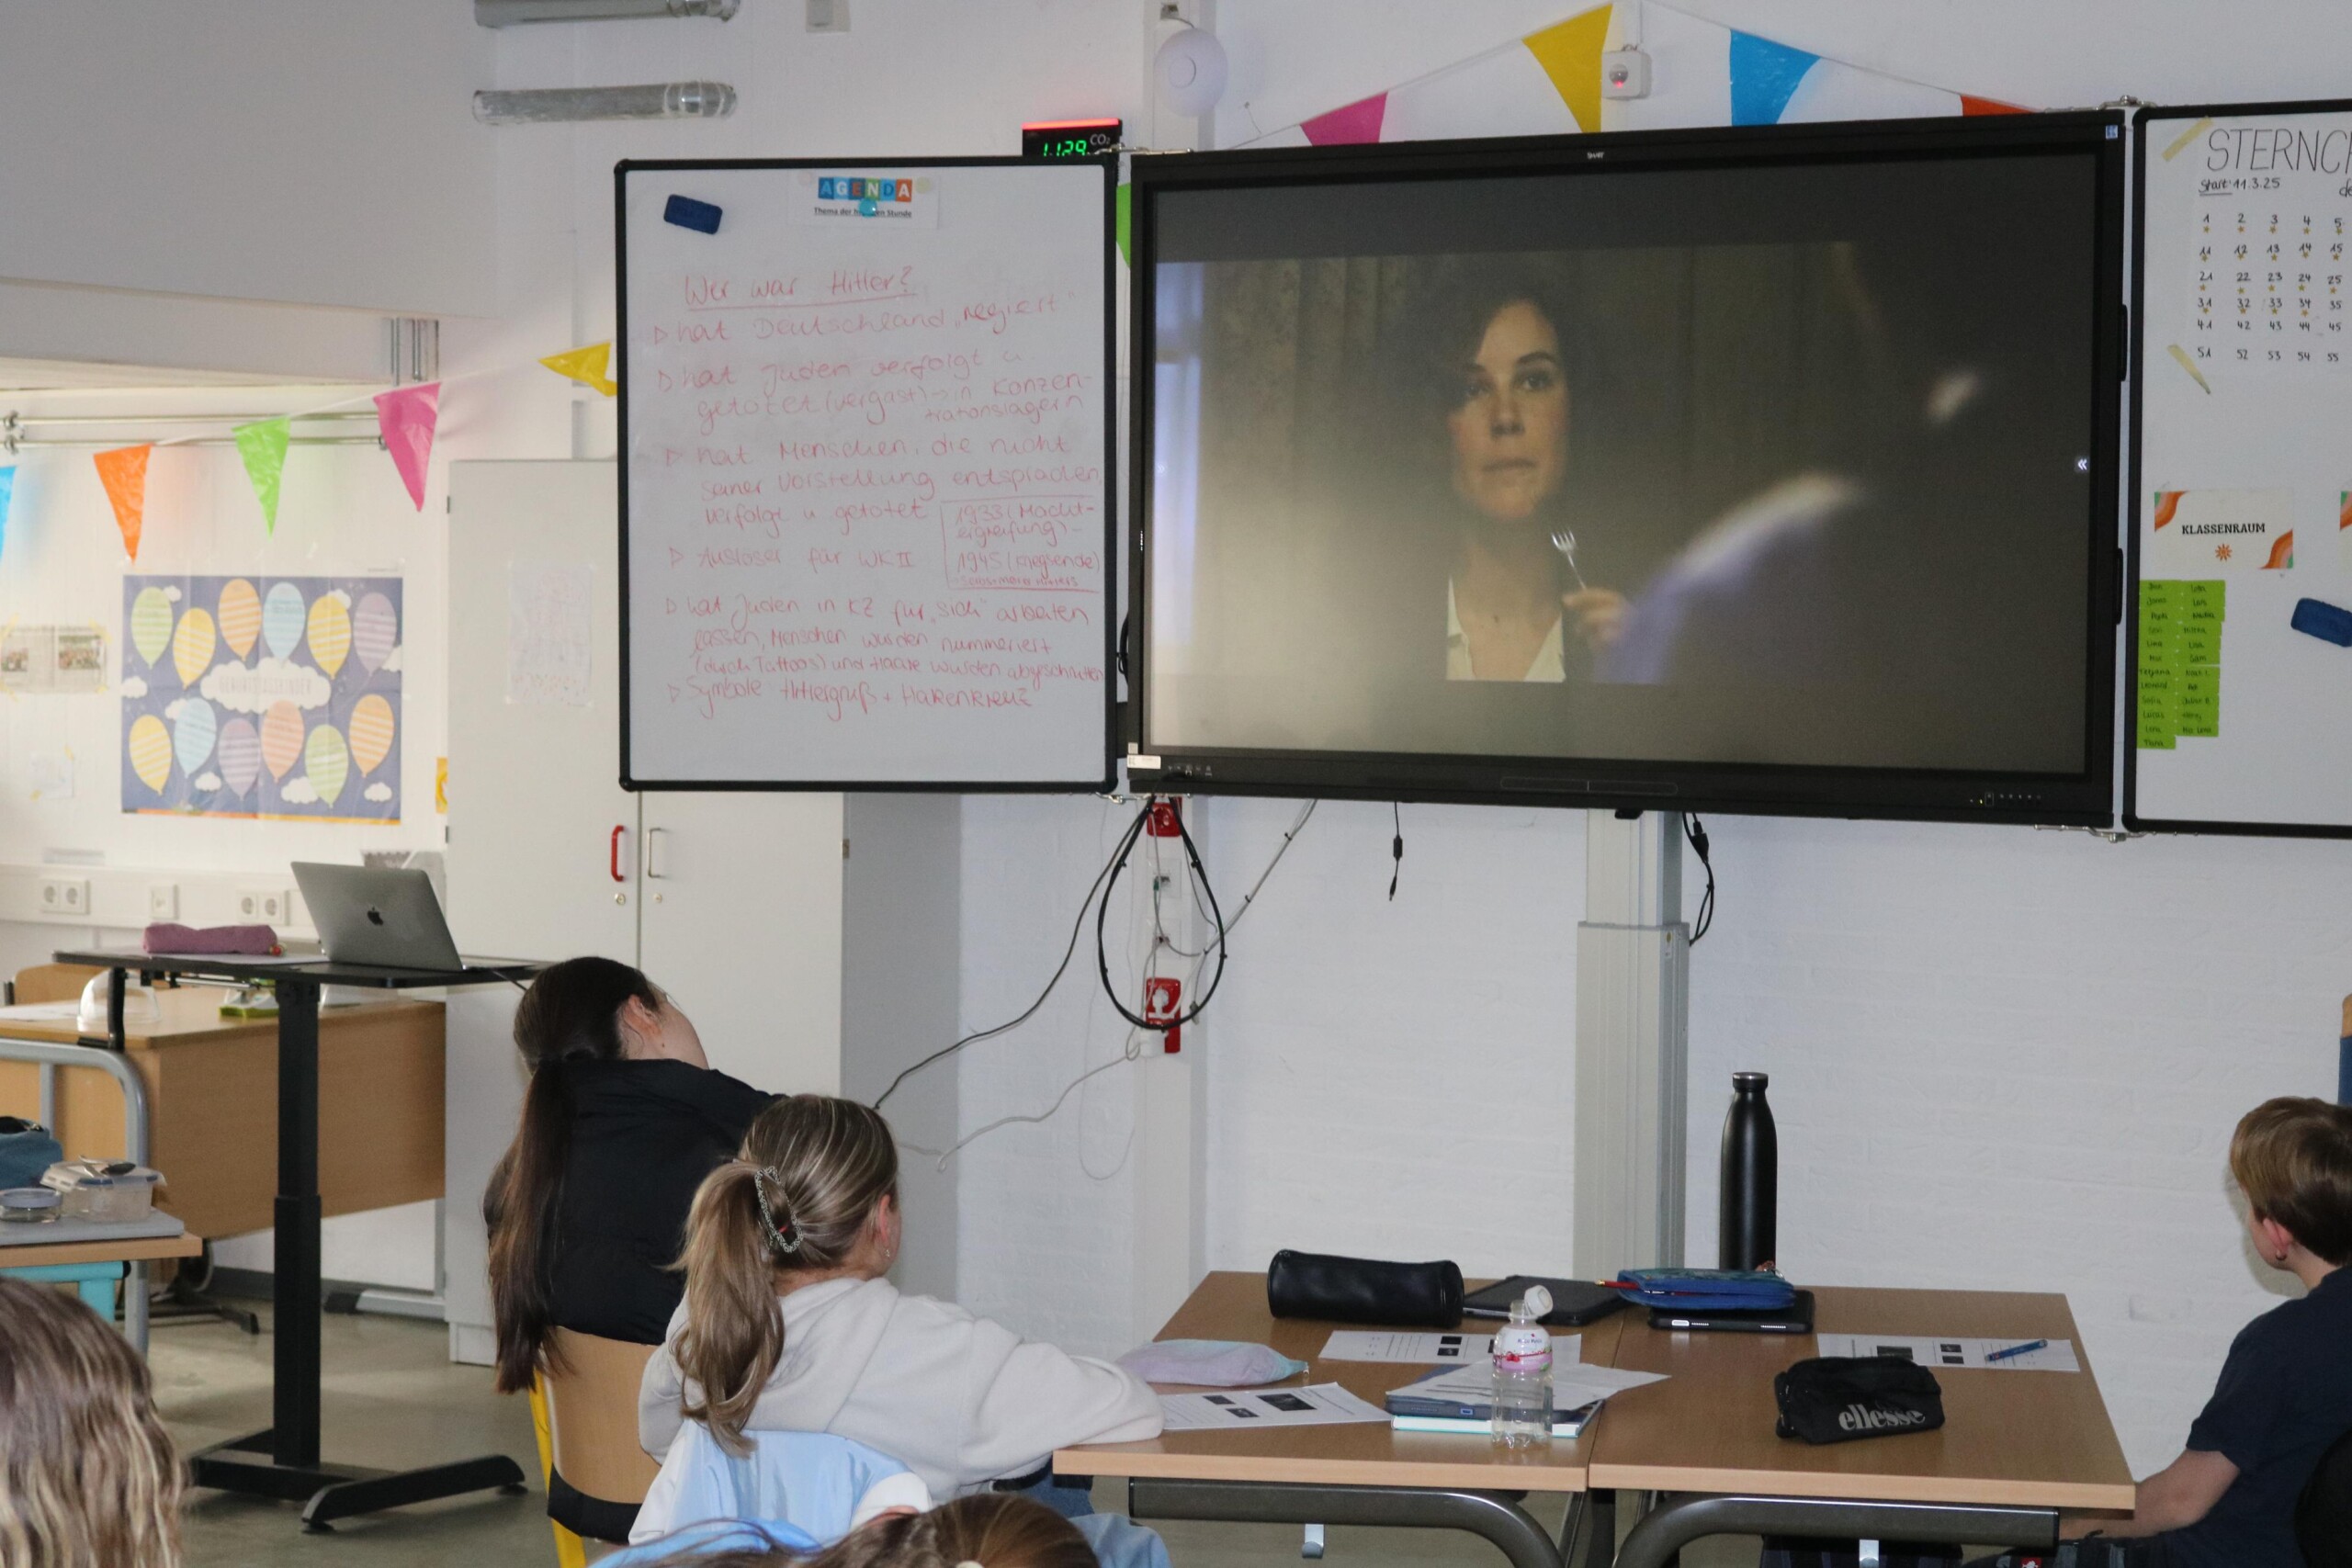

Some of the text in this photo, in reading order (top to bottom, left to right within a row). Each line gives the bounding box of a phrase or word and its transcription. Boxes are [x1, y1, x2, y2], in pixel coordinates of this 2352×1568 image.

[1043, 140, 1087, 156] 1129
[820, 179, 911, 199] AGENDA
[2233, 177, 2281, 190] 11.3.25
[814, 207, 838, 216] Thema
[840, 208, 852, 216] der
[887, 210, 911, 220] Stunde
[2203, 213, 2342, 227] 1 2 3 4 5
[2199, 243, 2343, 255] 11 12 13 14 15
[685, 265, 912, 306] Wer war Hitler?
[2199, 271, 2342, 285] 21 22 23 24 25
[2198, 298, 2342, 310] 31 32 33 34 35
[678, 319, 730, 344] hat
[753, 309, 945, 340] Deutschland
[2198, 320, 2342, 332] 41 42 43 44 45
[2198, 347, 2339, 362] 51 52 53 54 55
[683, 365, 735, 389] hat
[761, 361, 850, 398] Juden
[871, 348, 984, 380] verfolgt
[826, 385, 928, 425] (vergast)
[955, 386, 972, 401] in
[993, 372, 1092, 397] Konzen-
[697, 434, 1072, 466] hat Menschen, die nicht
[701, 479, 764, 502] seiner
[778, 468, 935, 502] Vorstellung
[956, 503, 1002, 525] 1933
[2181, 523, 2266, 536] KLASSENRAUM
[808, 547, 842, 573] für
[859, 551, 894, 569] WK
[898, 551, 917, 569] II
[957, 550, 1002, 573] 1945
[687, 594, 722, 617] hat
[730, 592, 800, 633] Juden
[817, 598, 836, 614] in
[848, 596, 875, 619] KZ
[892, 598, 924, 626] für
[996, 602, 1090, 626] arbeiten
[689, 626, 1053, 655] lassen, Menschen wurden nummeriert
[695, 654, 752, 675] (durch
[758, 654, 826, 674] Tattoos)
[831, 659, 865, 671] und
[869, 655, 921, 673] Haare
[929, 660, 1001, 678] wurden
[685, 675, 763, 720] Symbole
[779, 677, 878, 722] Hitlergruß
[901, 682, 1035, 708] Hakenkreuz
[1838, 1404, 1926, 1431] ellesse
